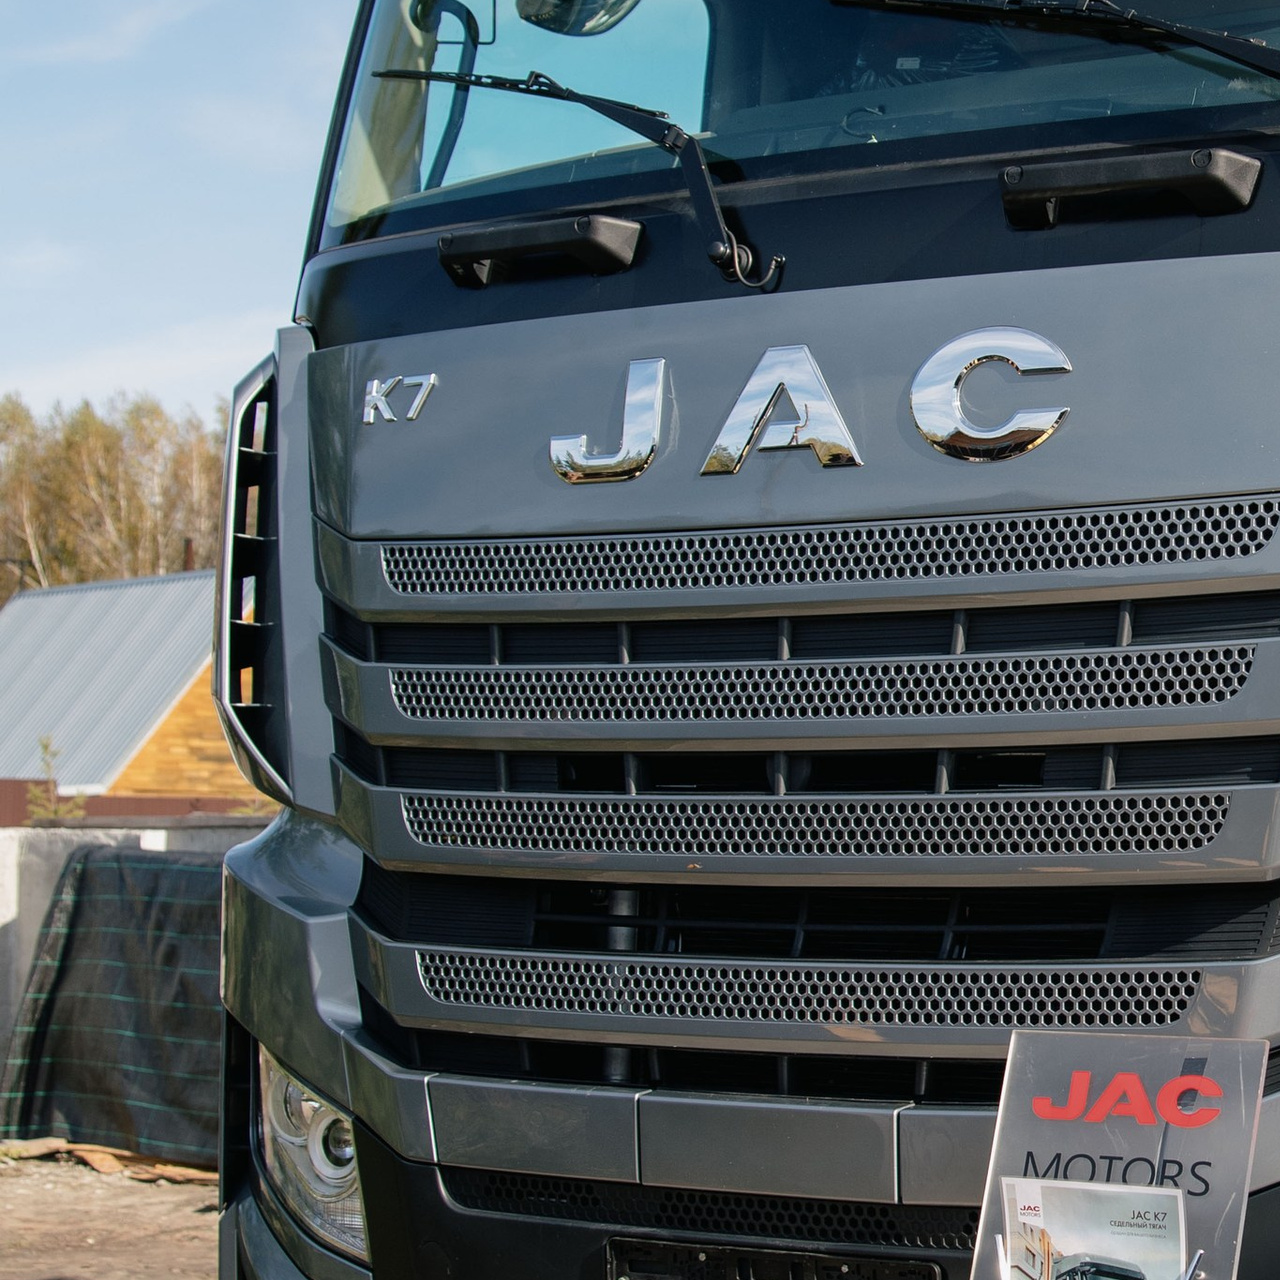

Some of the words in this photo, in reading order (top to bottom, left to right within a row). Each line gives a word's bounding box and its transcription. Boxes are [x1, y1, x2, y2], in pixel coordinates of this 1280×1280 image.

[362, 372, 439, 425] K7
[549, 325, 1073, 486] JAC
[1032, 1070, 1224, 1128] JAC
[1023, 1151, 1212, 1196] MOTORS
[1019, 1204, 1041, 1213] JAC
[1109, 1220, 1148, 1229] СЕДЕЛЬНЫЙ
[1131, 1210, 1151, 1221] JAC
[1153, 1211, 1167, 1222] K7
